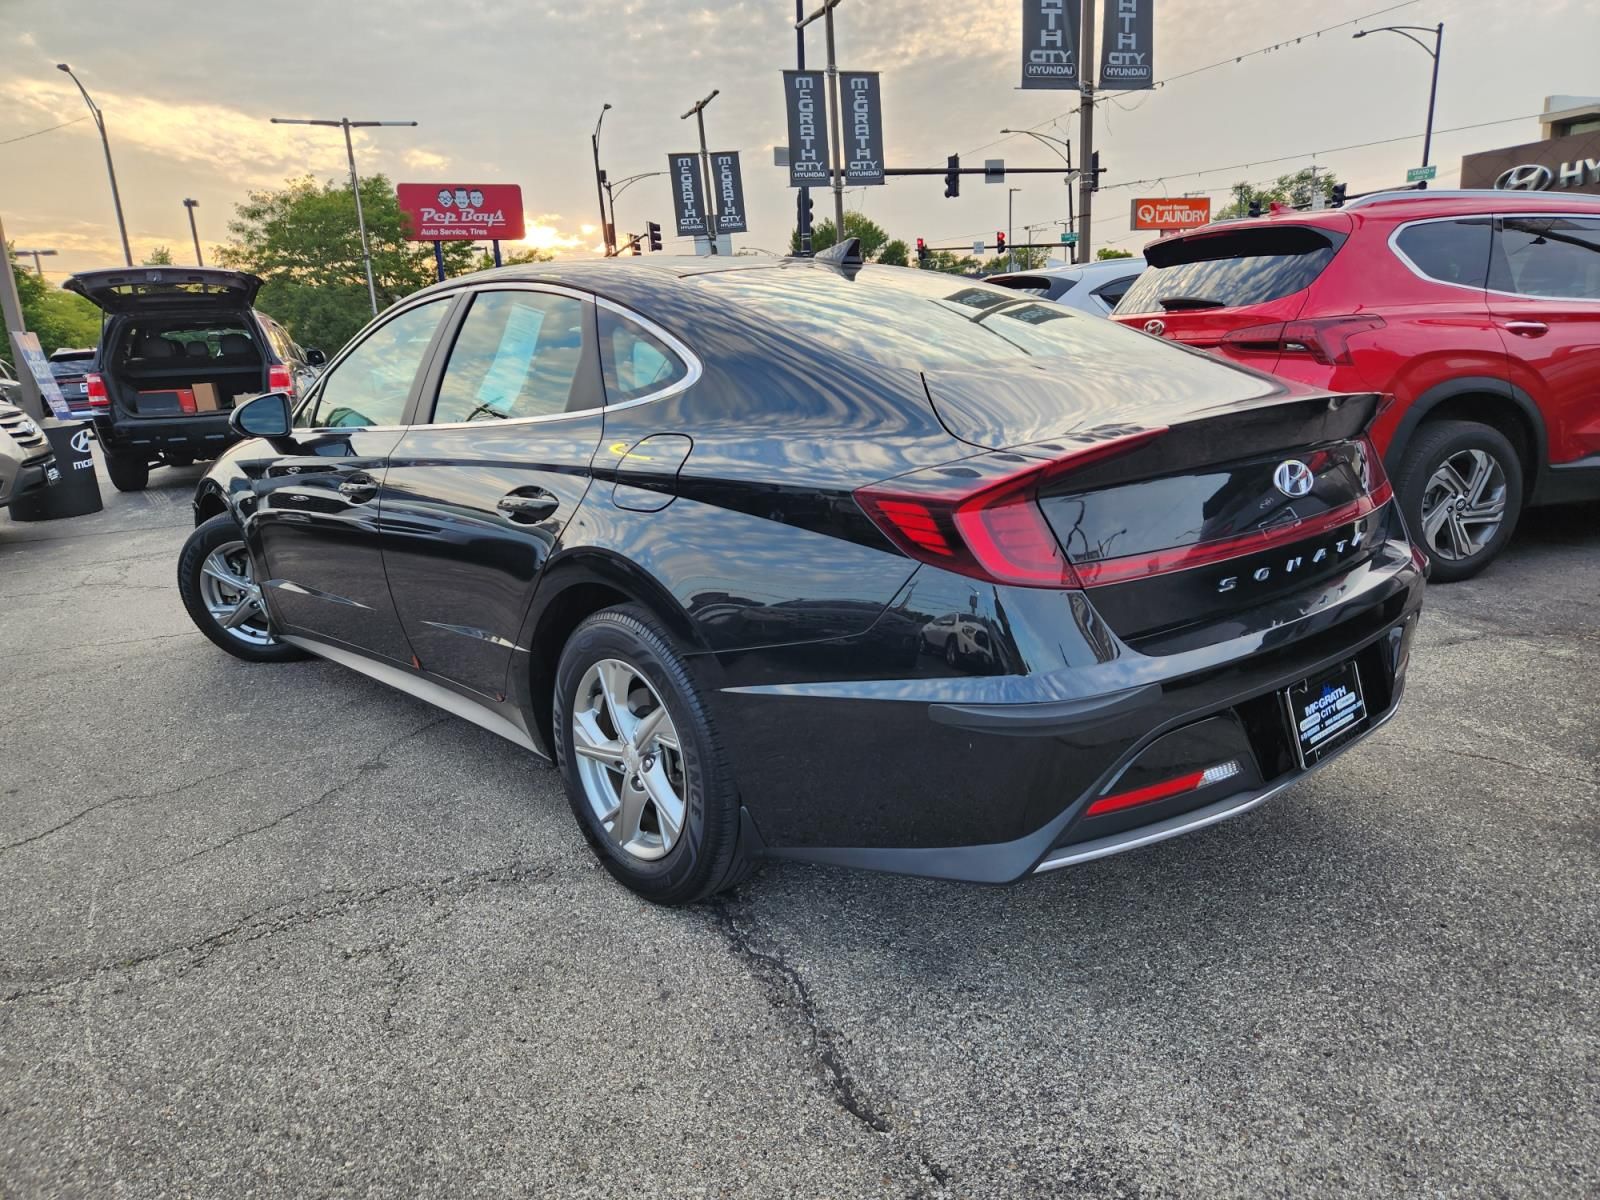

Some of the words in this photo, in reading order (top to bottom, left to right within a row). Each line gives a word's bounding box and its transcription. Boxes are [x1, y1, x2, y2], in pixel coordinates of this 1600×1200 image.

[1030, 50, 1071, 63] CITY
[1109, 52, 1145, 65] CITY
[1028, 65, 1073, 75] HYUNDAI
[1106, 67, 1147, 76] HYUNDAI
[794, 161, 824, 171] CITY
[849, 160, 878, 170] CITY
[849, 169, 880, 177] HYUNDAI
[1560, 158, 1600, 188] HY
[420, 207, 459, 225] Pep
[459, 207, 506, 227] Boys
[680, 217, 701, 225] CITY
[720, 215, 741, 223] CITY
[1155, 210, 1208, 223] LAUNDRY
[1320, 702, 1337, 719] CITY
